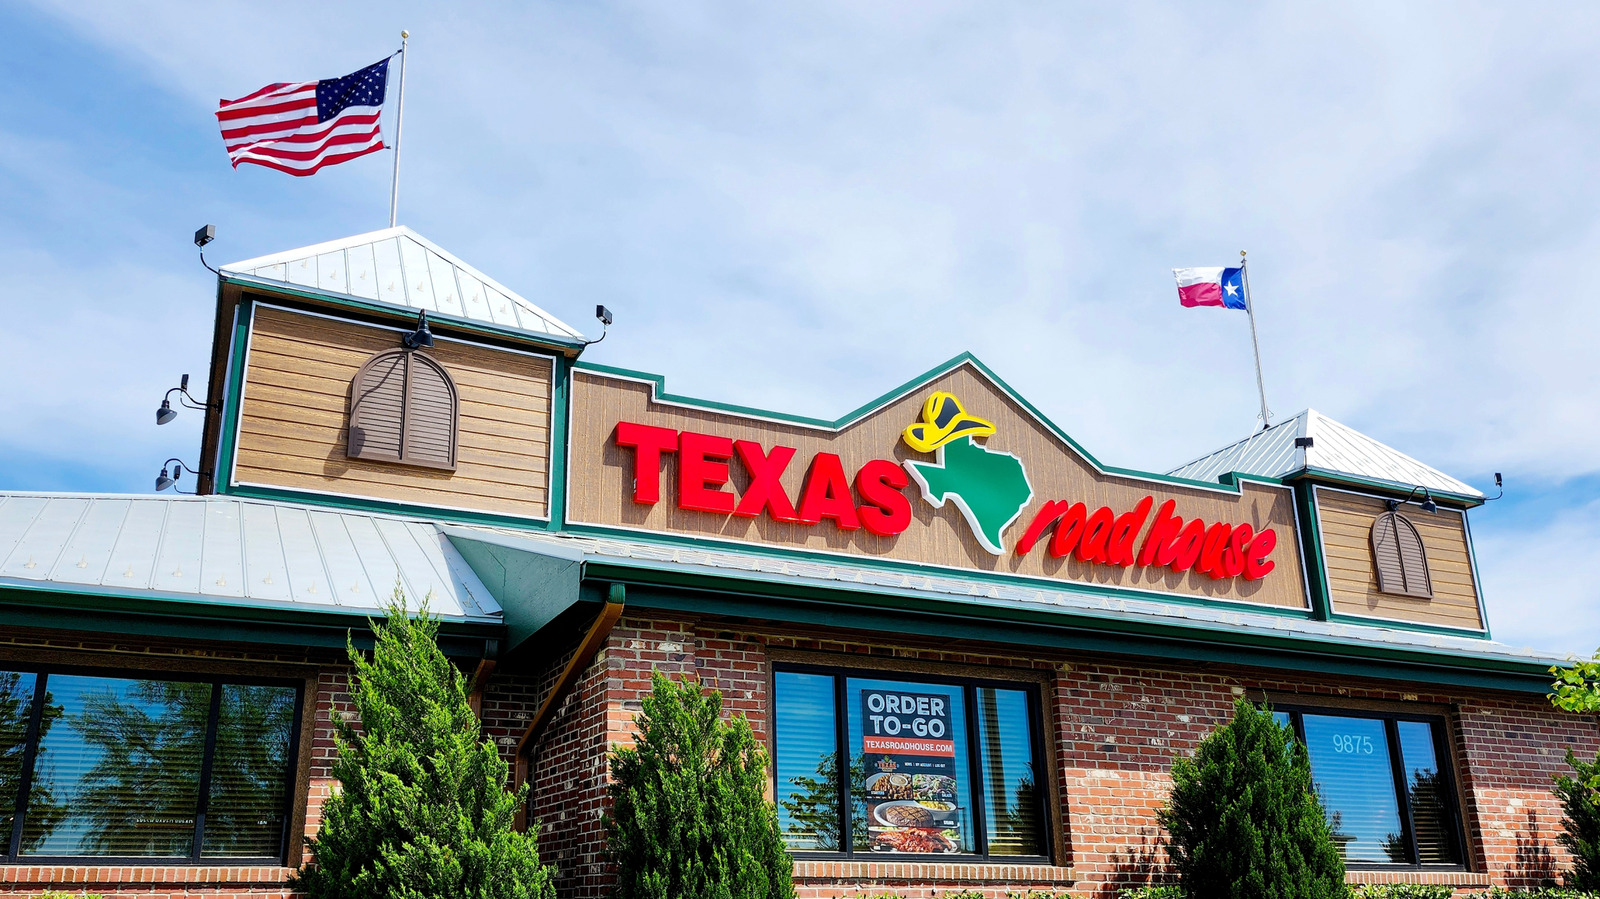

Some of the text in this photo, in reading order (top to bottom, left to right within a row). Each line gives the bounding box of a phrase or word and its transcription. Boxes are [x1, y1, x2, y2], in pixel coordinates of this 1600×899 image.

[615, 421, 912, 537] TEXAS
[867, 693, 945, 716] ORDER
[869, 715, 945, 738] TO-GO
[866, 740, 953, 752] TEXASROADHOUSE.COM
[1333, 734, 1373, 754] 9875
